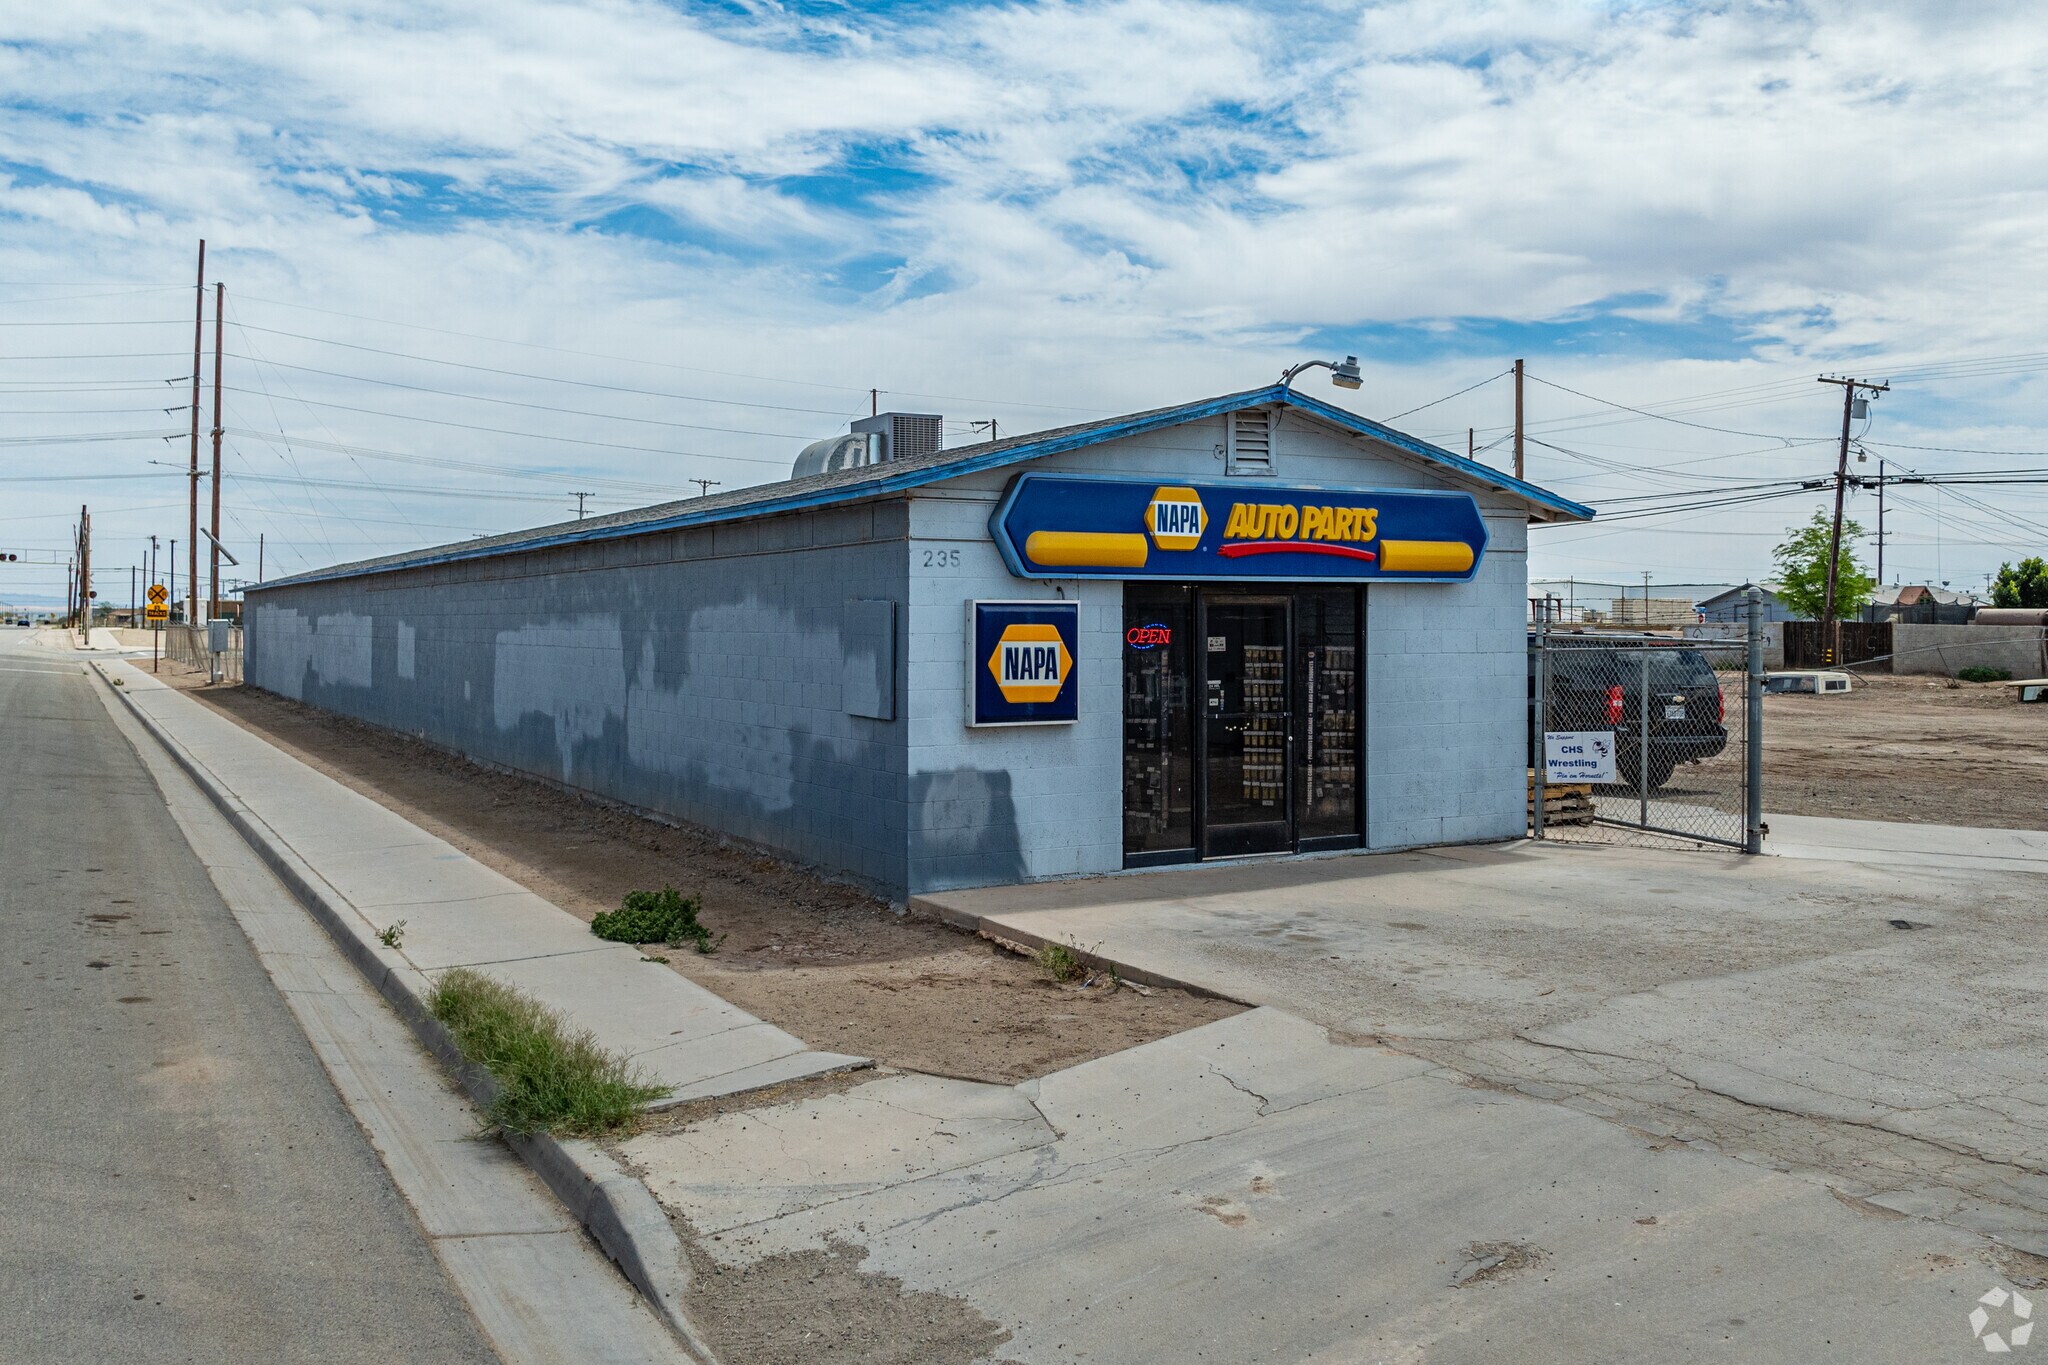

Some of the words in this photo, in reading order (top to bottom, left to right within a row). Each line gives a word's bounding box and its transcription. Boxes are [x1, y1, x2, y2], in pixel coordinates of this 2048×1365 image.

[1157, 503, 1199, 534] NAPA
[1223, 503, 1299, 541] AUTO
[1300, 505, 1379, 542] PARTS
[923, 550, 961, 567] 235
[1127, 627, 1171, 645] OPEN
[1005, 646, 1058, 680] NAPA
[1561, 745, 1583, 754] CHS
[1548, 759, 1597, 769] Wrestling
